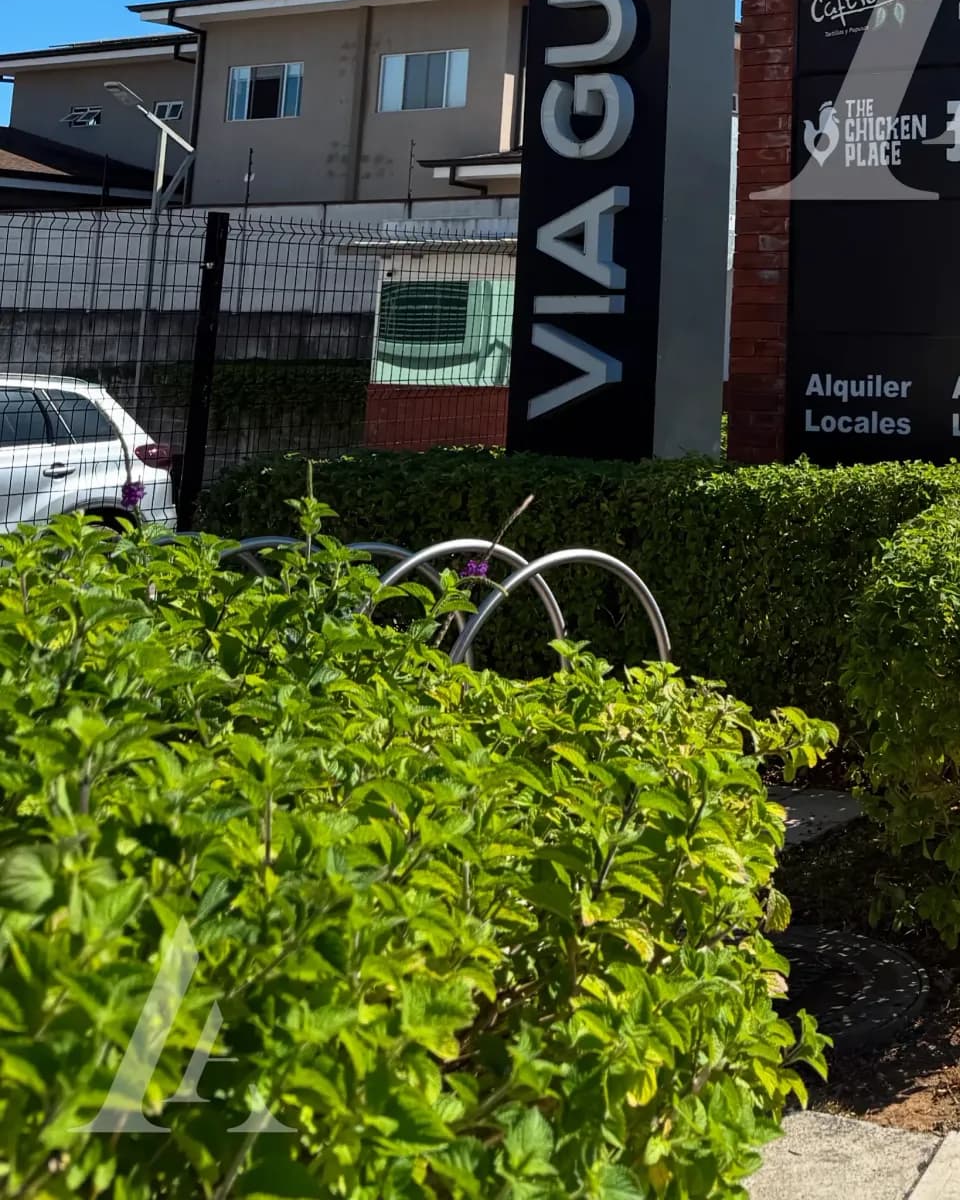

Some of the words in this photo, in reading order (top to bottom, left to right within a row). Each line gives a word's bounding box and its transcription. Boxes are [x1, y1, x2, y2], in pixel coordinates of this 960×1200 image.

[845, 99, 874, 117] THE
[845, 115, 927, 142] CHICKEN
[845, 140, 902, 167] PLACE
[527, 185, 630, 421] VIA
[805, 373, 912, 402] Alquiler
[805, 409, 912, 435] Locales
